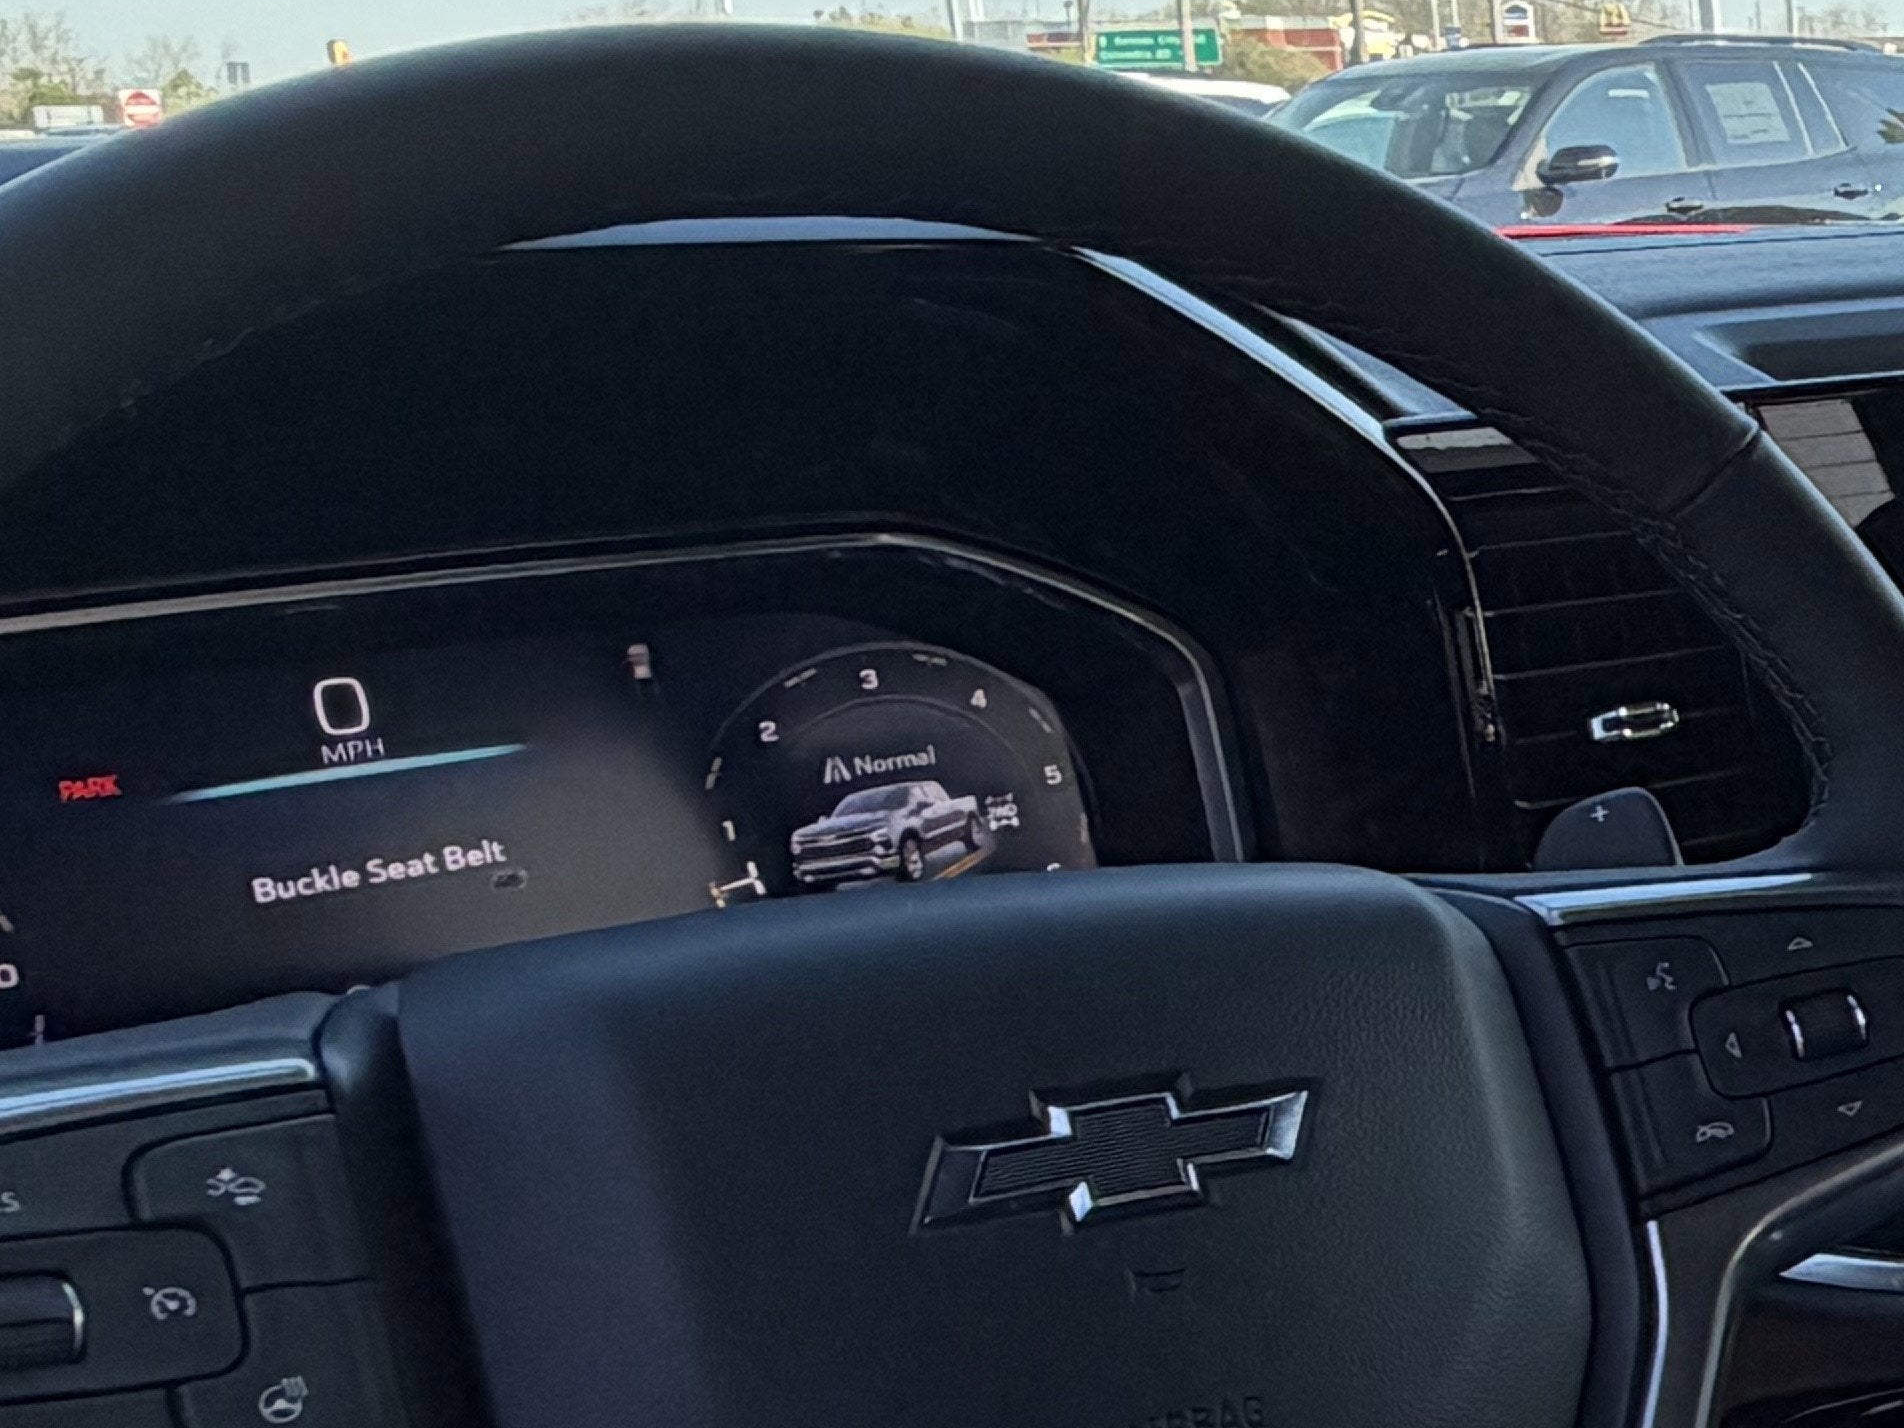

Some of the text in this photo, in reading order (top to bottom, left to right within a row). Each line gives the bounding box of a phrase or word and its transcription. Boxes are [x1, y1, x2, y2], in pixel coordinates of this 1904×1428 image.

[859, 668, 878, 690] 3
[314, 676, 371, 736] 0
[970, 689, 988, 709] 4
[758, 720, 780, 743] 2
[320, 738, 386, 765] MPH
[853, 744, 937, 777] Normal
[1044, 764, 1063, 785] 5
[58, 775, 122, 803] PARK
[722, 820, 736, 842] 1
[252, 839, 508, 904] Buckle Seat Belt
